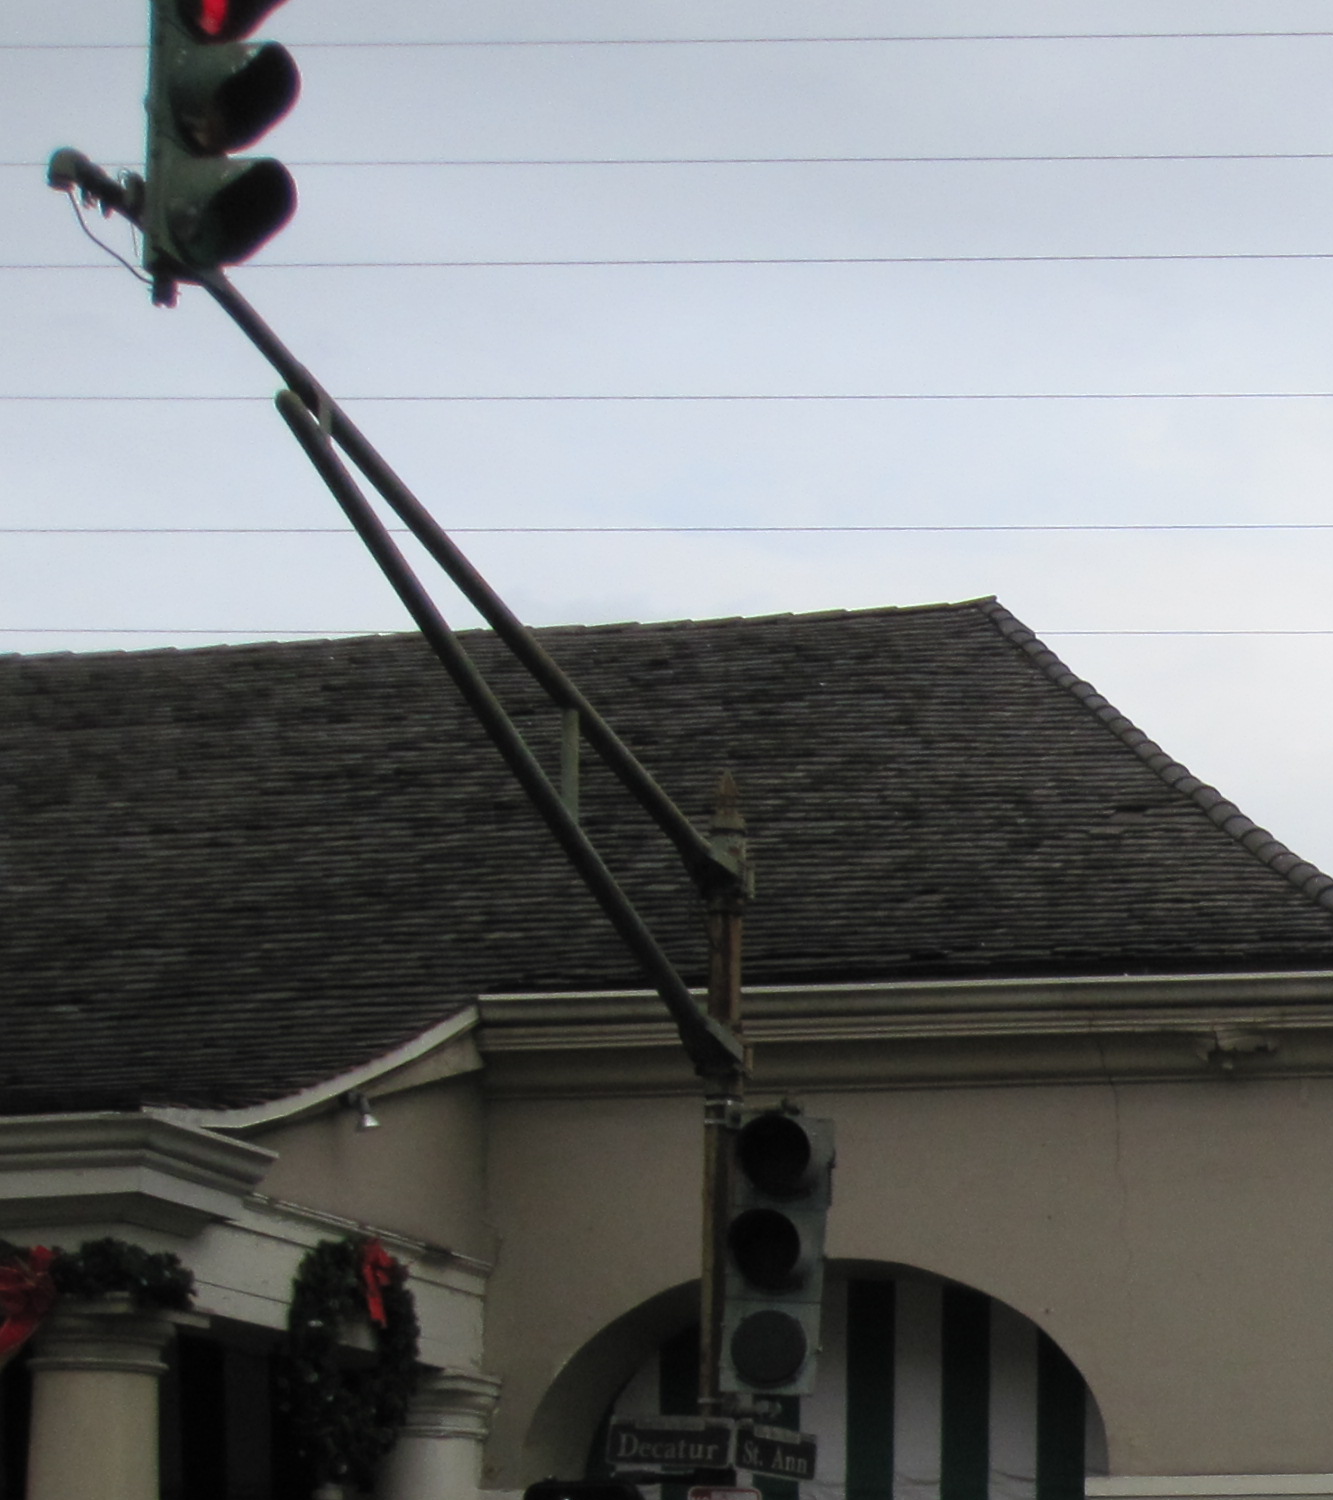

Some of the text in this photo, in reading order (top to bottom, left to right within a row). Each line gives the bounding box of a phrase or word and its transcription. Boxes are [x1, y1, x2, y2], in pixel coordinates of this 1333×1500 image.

[617, 1431, 720, 1461] Decatur
[742, 1439, 809, 1474] St. Ann
